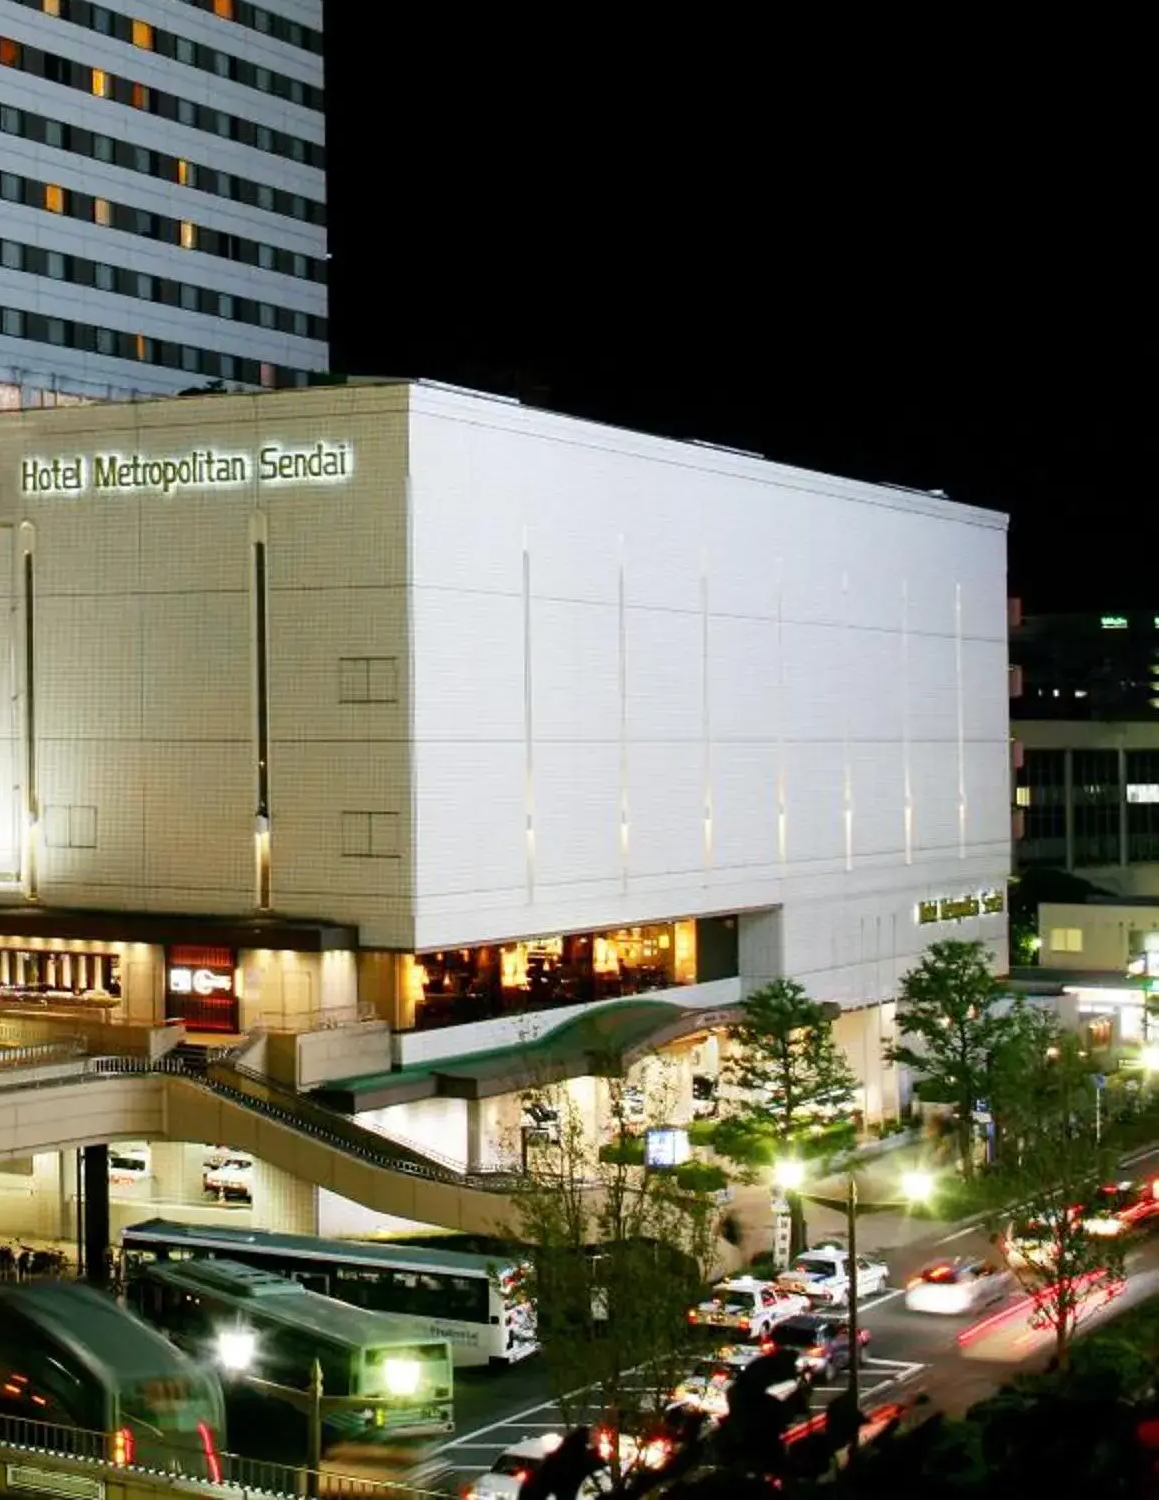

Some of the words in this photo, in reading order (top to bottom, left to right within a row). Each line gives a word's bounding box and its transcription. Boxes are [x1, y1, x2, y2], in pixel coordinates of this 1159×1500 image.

[21, 457, 83, 492] Hotel
[94, 451, 246, 492] Metropolitan
[259, 444, 348, 481] Sendai
